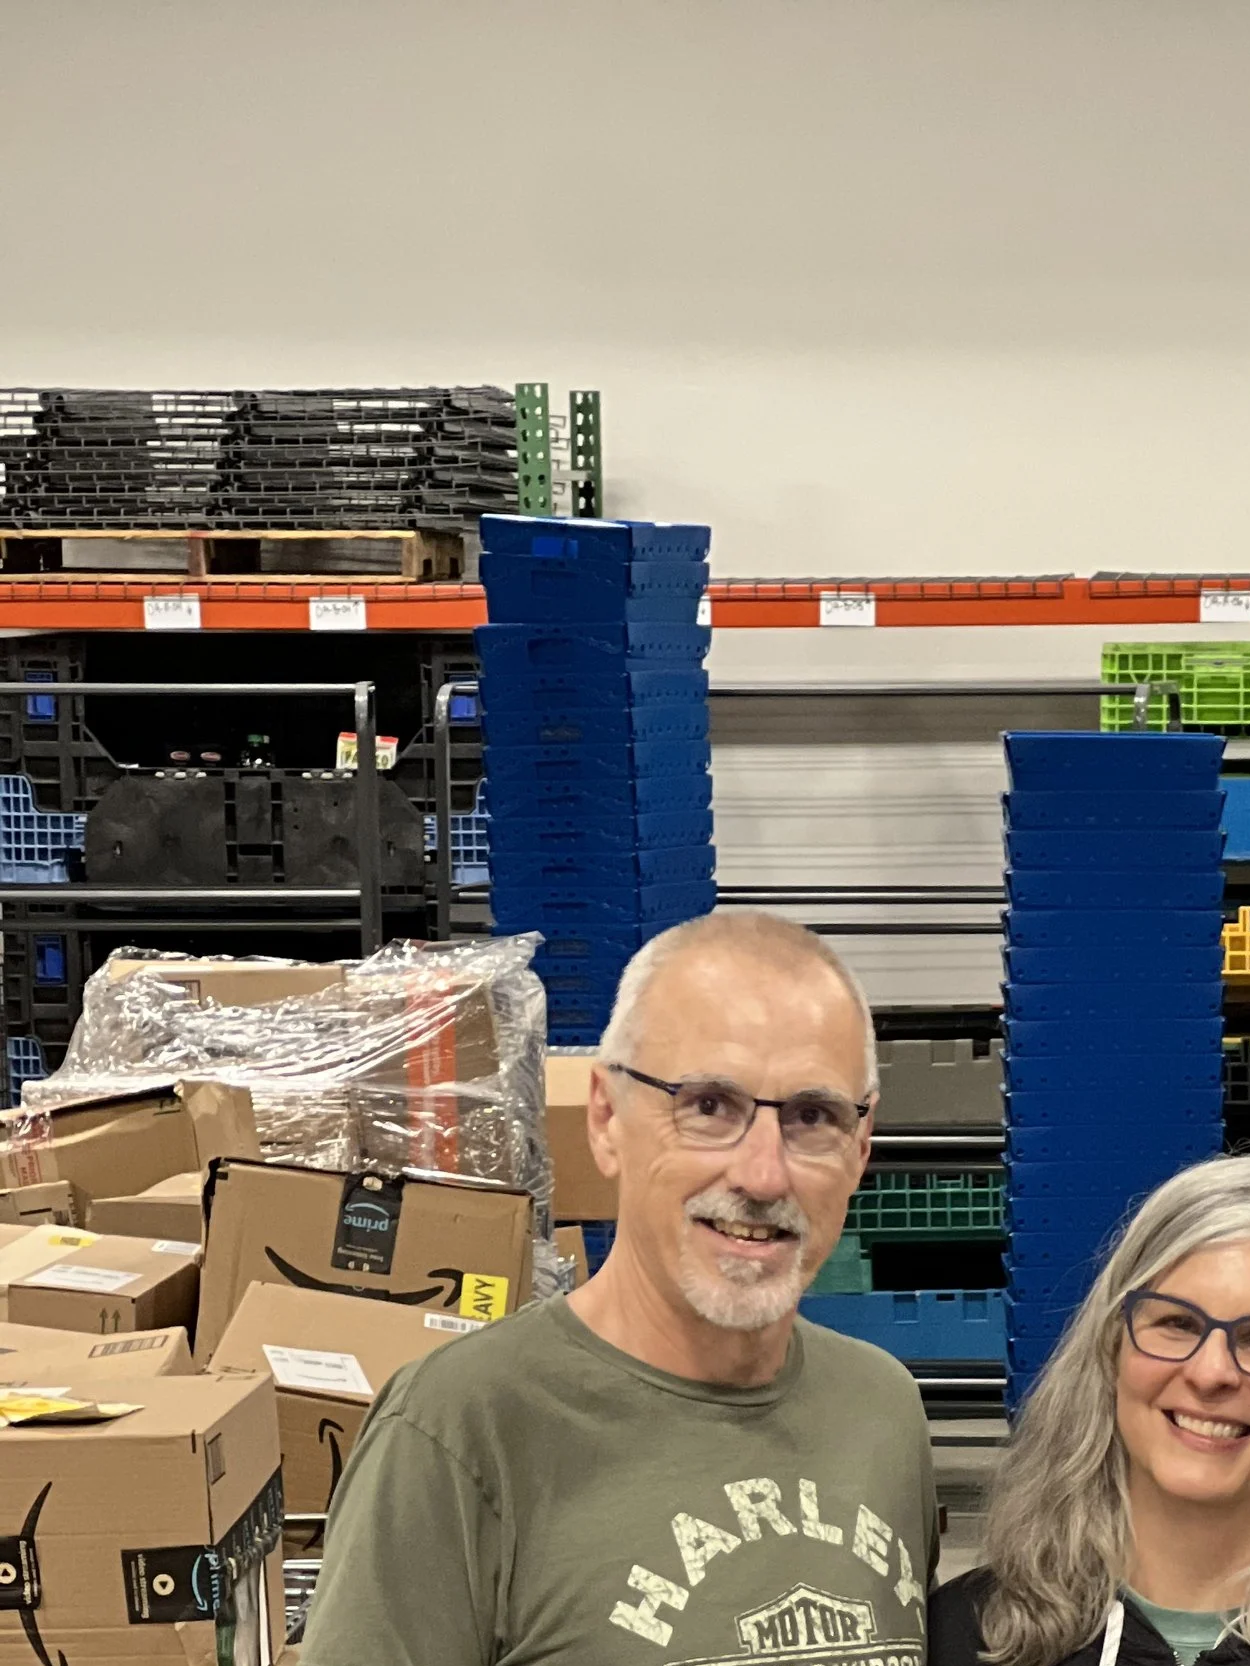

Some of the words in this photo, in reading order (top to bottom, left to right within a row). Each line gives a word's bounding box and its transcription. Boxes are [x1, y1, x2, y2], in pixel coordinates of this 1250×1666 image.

[344, 1214, 389, 1233] prime
[472, 1278, 495, 1321] AVY
[754, 1602, 864, 1650] MOTOR
